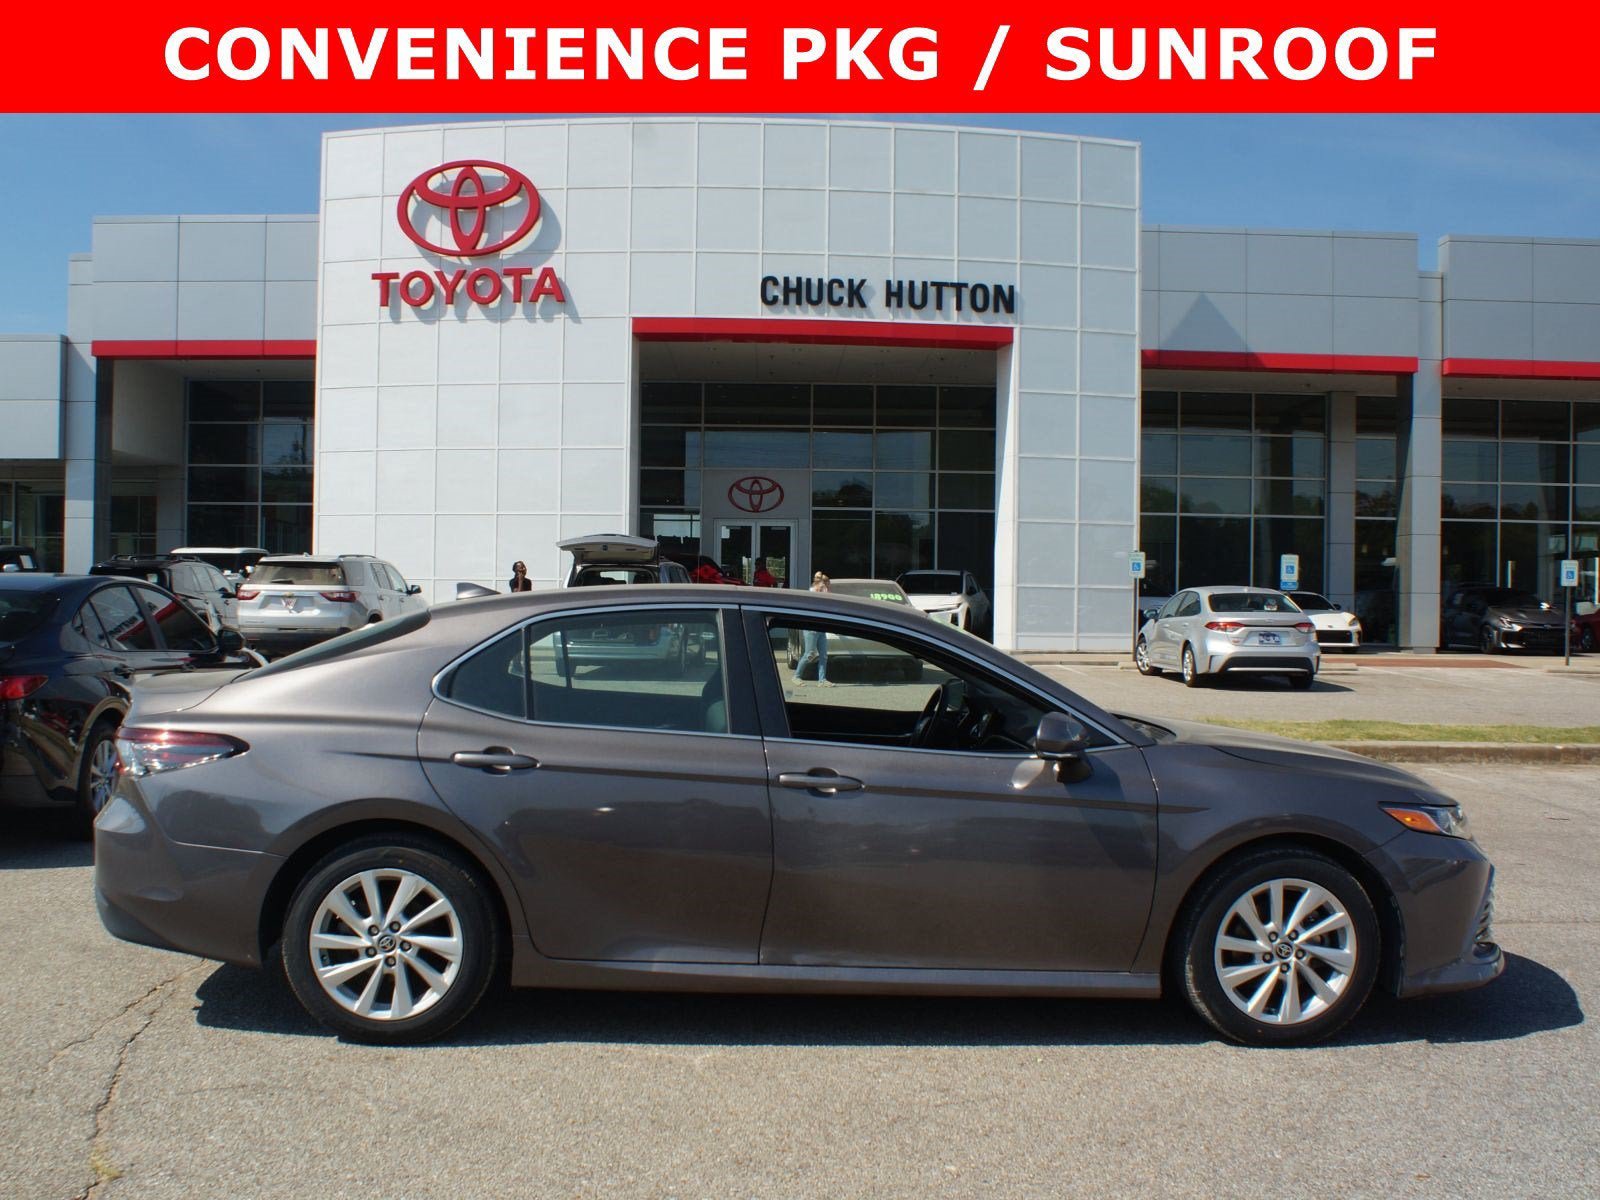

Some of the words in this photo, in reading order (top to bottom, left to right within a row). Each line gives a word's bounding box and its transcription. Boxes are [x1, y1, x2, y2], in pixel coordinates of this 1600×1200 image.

[372, 267, 565, 307] TOYOTA
[761, 276, 866, 308] CHUCK
[886, 280, 1014, 313] HUTTON
